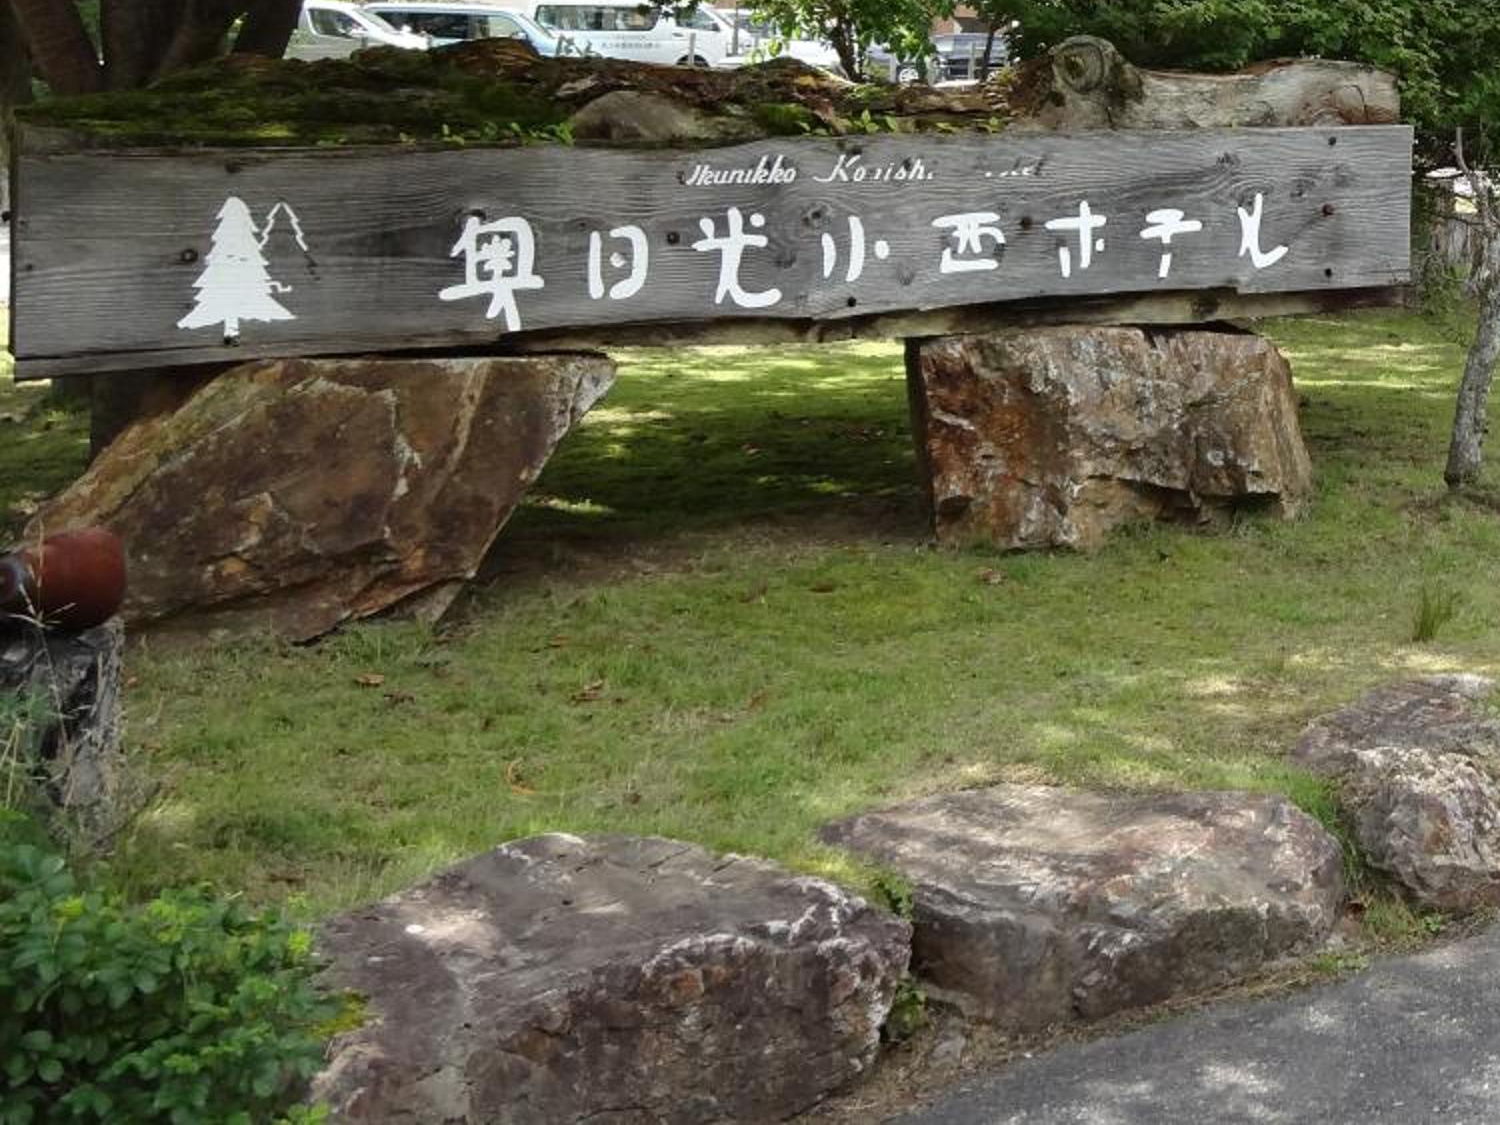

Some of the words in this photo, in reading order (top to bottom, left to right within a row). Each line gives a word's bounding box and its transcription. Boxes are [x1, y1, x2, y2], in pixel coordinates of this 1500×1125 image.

[439, 192, 1289, 332] 奥日光小西ホテル
